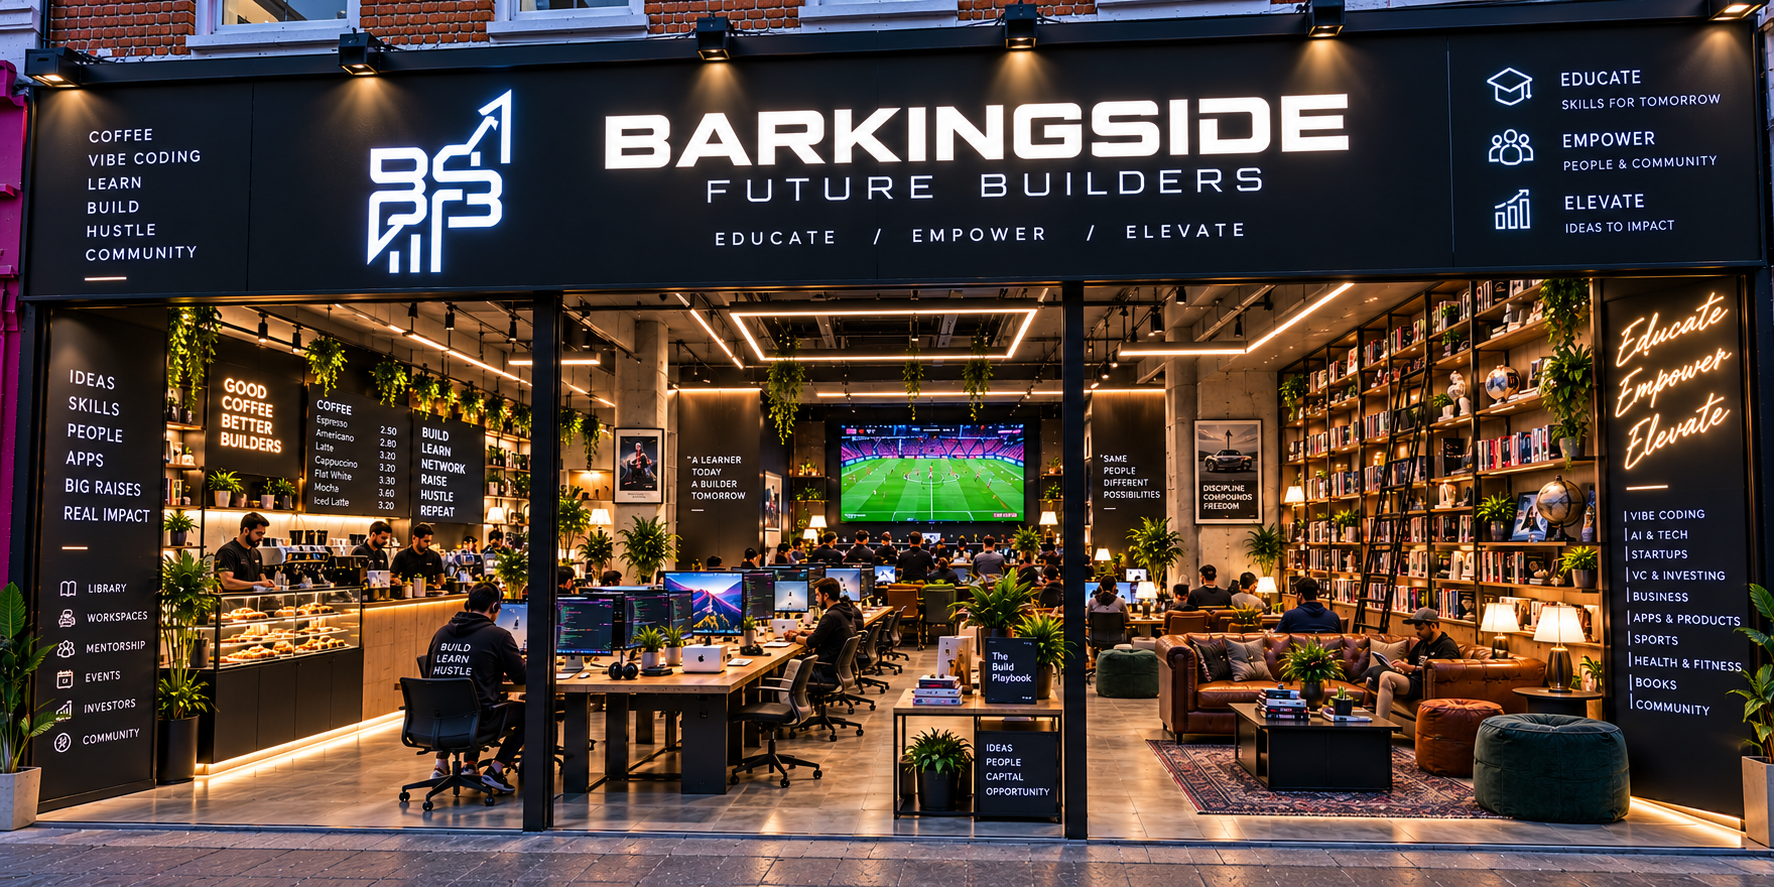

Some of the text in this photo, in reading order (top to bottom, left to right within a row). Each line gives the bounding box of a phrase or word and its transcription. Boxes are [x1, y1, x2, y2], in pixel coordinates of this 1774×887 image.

[1561, 69, 1641, 87] EDUCATE
[1561, 93, 1721, 110] SKILLS FOR TOMORROW
[89, 128, 153, 144] COFFEE
[604, 93, 1350, 170] BARKINGSIDE
[1562, 131, 1655, 148] EMPOWER
[88, 149, 201, 167] VIBE CODING
[1563, 155, 1718, 171] PEOPLE & COMMUNITY
[87, 176, 142, 191] LEARN
[707, 167, 1263, 204] FUTURE BUILDERS
[87, 200, 140, 215] BUILD
[1564, 194, 1645, 210] ELEVATE
[86, 223, 156, 238] HUSTLE
[715, 230, 835, 246] EDUCATE
[912, 226, 1045, 243] EMPOWER
[1126, 222, 1244, 239] ELEVATE
[1565, 219, 1675, 234] IDEAS TO IMPACT
[85, 245, 197, 262] COMMUNITY
[1616, 292, 1729, 367] Educate
[69, 369, 115, 390] IDEAS
[1615, 348, 1732, 418] Empower
[224, 378, 267, 399] GOOD
[68, 396, 120, 417] SKILLS
[222, 395, 274, 418] COFFEE
[316, 399, 352, 415] COFFEE
[221, 414, 273, 435] BETTER
[316, 415, 397, 436] Espresso 2.50
[1625, 392, 1731, 470] Elevate
[67, 423, 123, 443] PEOPLE
[315, 428, 355, 443] Americano
[422, 427, 449, 442] BUILD
[220, 431, 282, 454] BUILDERS
[421, 443, 452, 457] LEARN
[315, 441, 396, 461] Latte 3.20
[65, 450, 104, 468] APPS
[314, 455, 396, 473] Cappuccino 3.20
[701, 456, 742, 465] LEARNER
[421, 459, 466, 475] NETWORK
[692, 468, 722, 477] TODAY
[1103, 466, 1136, 475] PEOPLE
[314, 469, 329, 479] Flat
[331, 471, 352, 482] White
[421, 474, 448, 487] RAISE
[1103, 478, 1149, 487] DIFFERENT
[65, 478, 141, 497] BIG RAISES
[691, 480, 738, 489] A BUILDER
[1203, 484, 1245, 492] DISCIPLINE
[420, 489, 454, 503] HUSTLE
[691, 492, 746, 500] TOMORROW
[1103, 490, 1161, 499] POSSIBILITIES
[1203, 493, 1253, 501] COMPOUNDS
[331, 497, 350, 507] Latte
[377, 501, 395, 511] 3.20
[420, 505, 455, 518] REPEAT
[1203, 502, 1240, 510] FREEDOM
[64, 506, 150, 523] REAL IMPACT
[1630, 509, 1705, 521] VIBE CODING
[1630, 530, 1688, 540] AI & TECH
[1631, 549, 1688, 559] STARTUPS
[1632, 570, 1726, 581] VC & INVESTING
[88, 583, 127, 594] LIBRARY
[1633, 592, 1689, 602] BUSINESS
[87, 610, 148, 623] WORKSPACES
[1633, 613, 1741, 627] APPS & PRODUCTS
[86, 640, 146, 653] MENTORSHIP
[1634, 634, 1679, 645] SPORTS
[440, 643, 471, 652] BUILD
[436, 654, 469, 664] LEARN
[992, 652, 1008, 661] The
[1634, 656, 1742, 672] HEALTH & FITNESS
[433, 666, 472, 676] HUSTLE
[992, 663, 1014, 671] Build
[85, 670, 121, 683] EVENTS
[992, 674, 1032, 684] Playbook
[1635, 677, 1677, 690] BOOKS
[84, 698, 136, 714] INVESTORS
[1636, 700, 1710, 716] COMMUNITY
[83, 728, 140, 745] COMMUNITY
[986, 744, 1013, 752] IDEAS
[986, 758, 1022, 767] PEOPLE
[986, 773, 1024, 781] CAPITAL
[986, 788, 1050, 796] OPPORTUNITY
